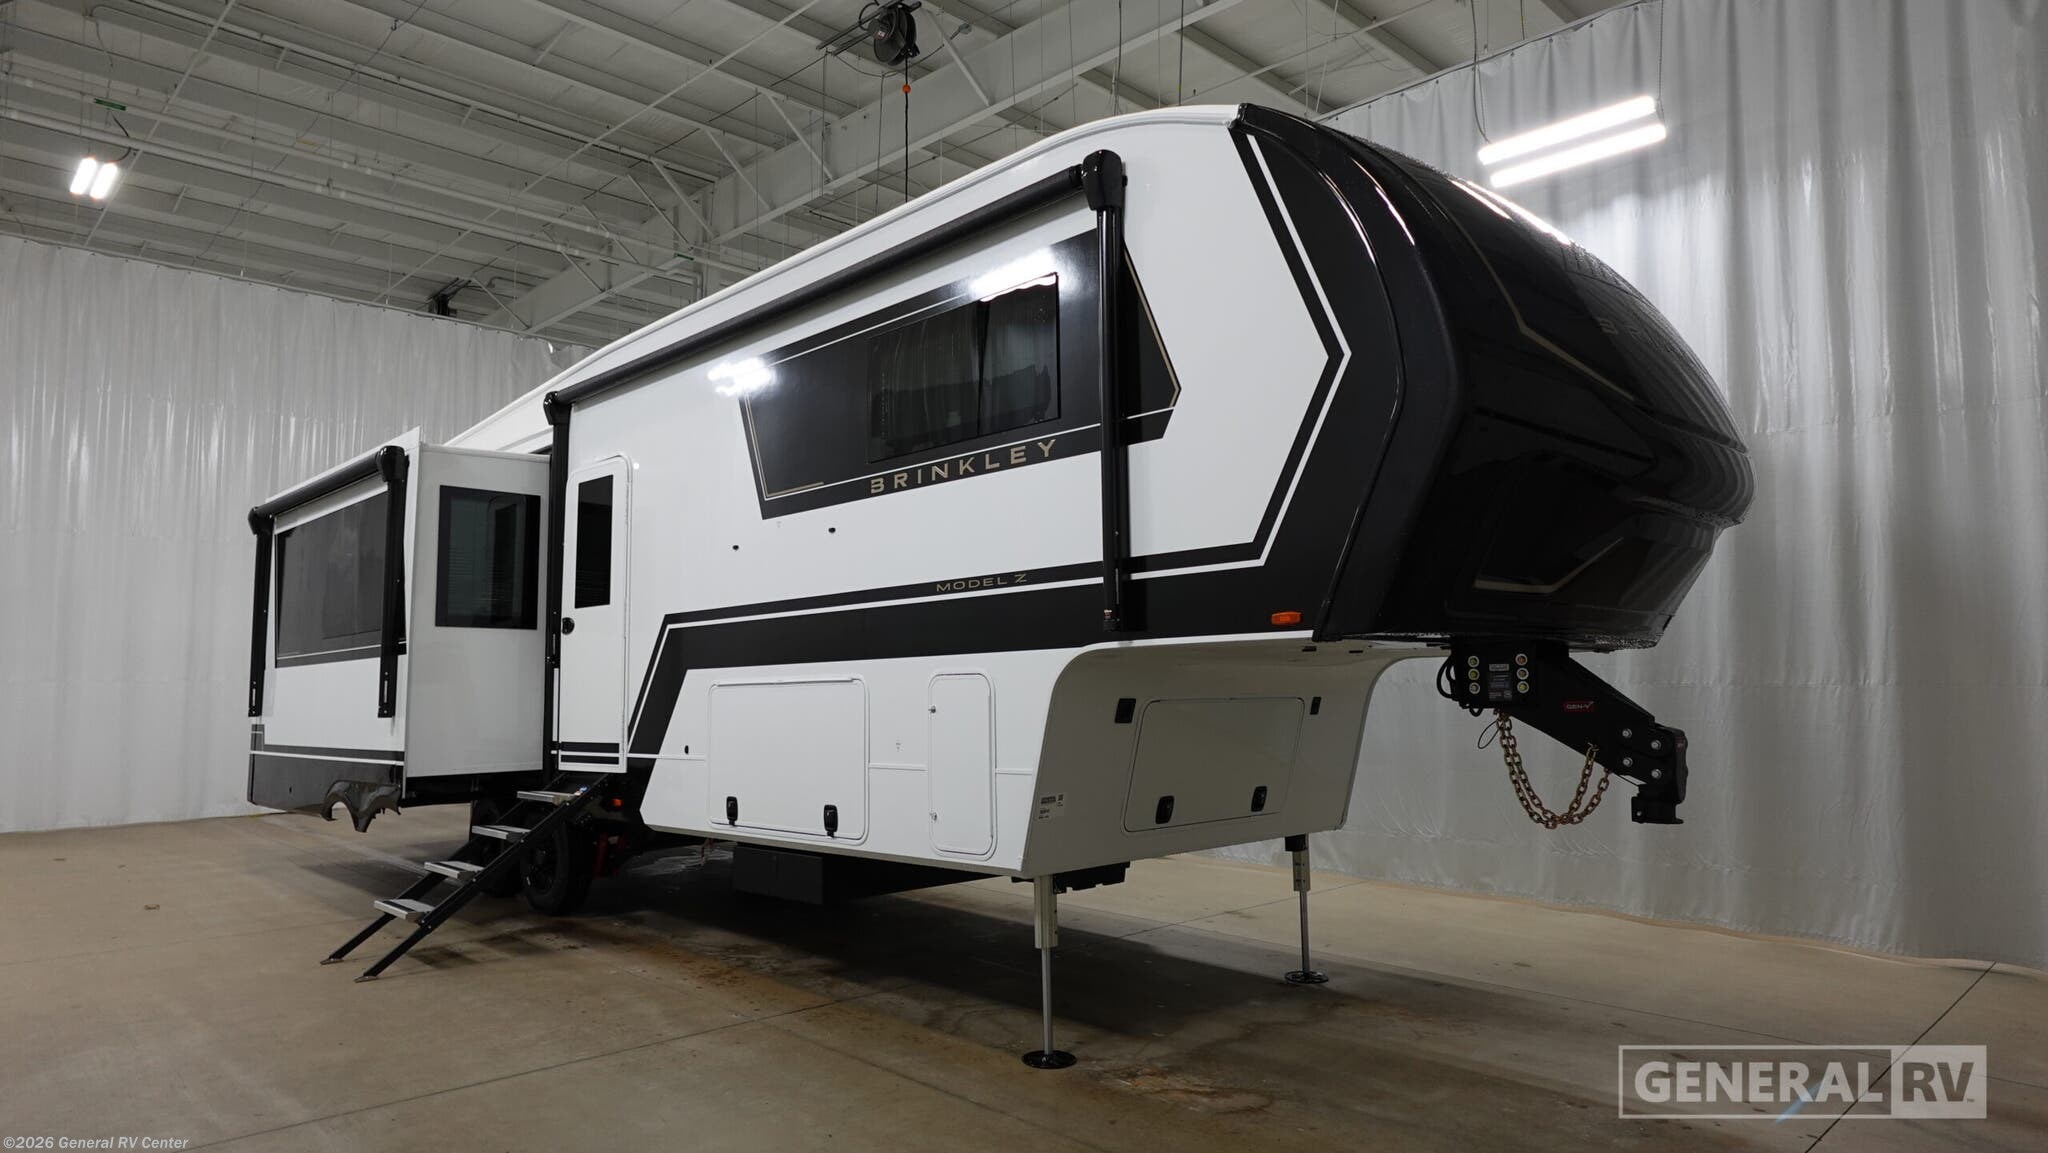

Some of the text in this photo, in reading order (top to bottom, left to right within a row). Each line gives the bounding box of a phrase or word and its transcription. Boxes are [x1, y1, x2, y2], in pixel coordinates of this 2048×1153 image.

[870, 439, 1056, 494] BRINKLEY
[936, 573, 1028, 592] MODEL Z
